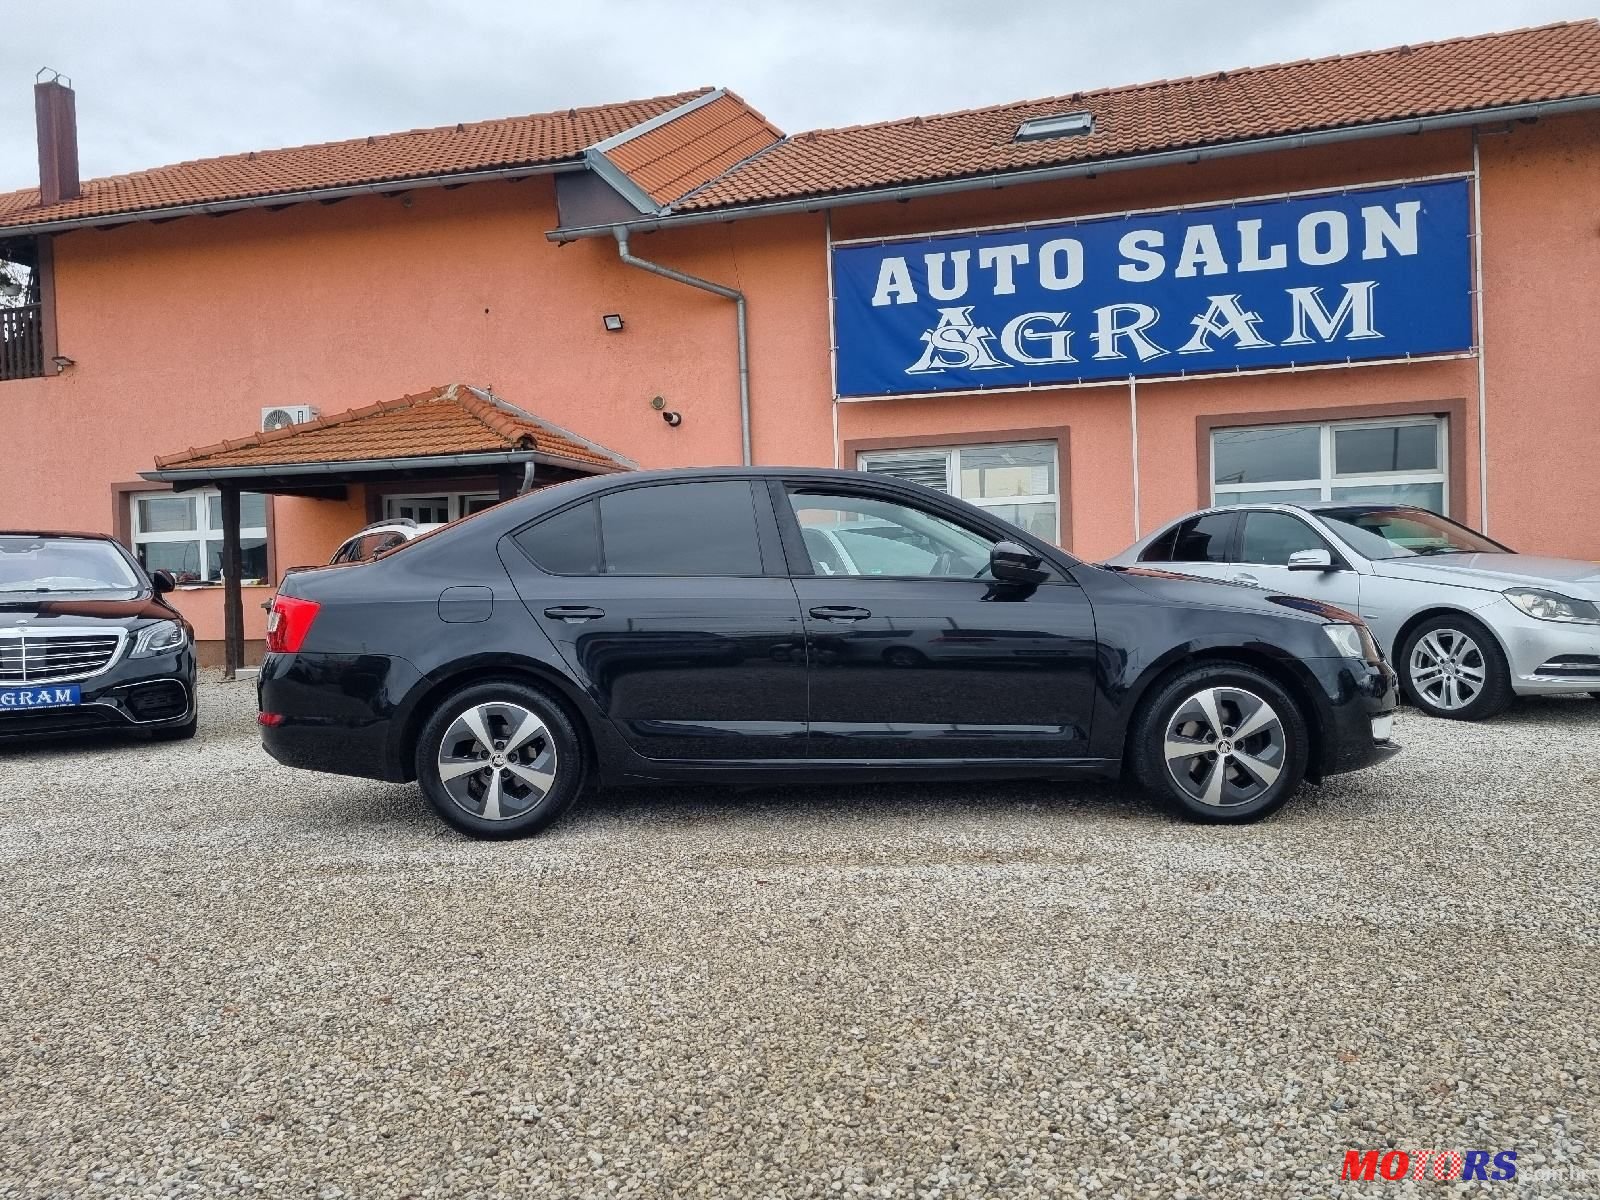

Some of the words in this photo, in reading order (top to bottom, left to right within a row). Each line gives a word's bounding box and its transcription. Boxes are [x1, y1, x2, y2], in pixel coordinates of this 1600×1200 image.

[872, 238, 1084, 307] AUTO
[1118, 200, 1421, 283] SALON
[0, 688, 73, 706] GRAM
